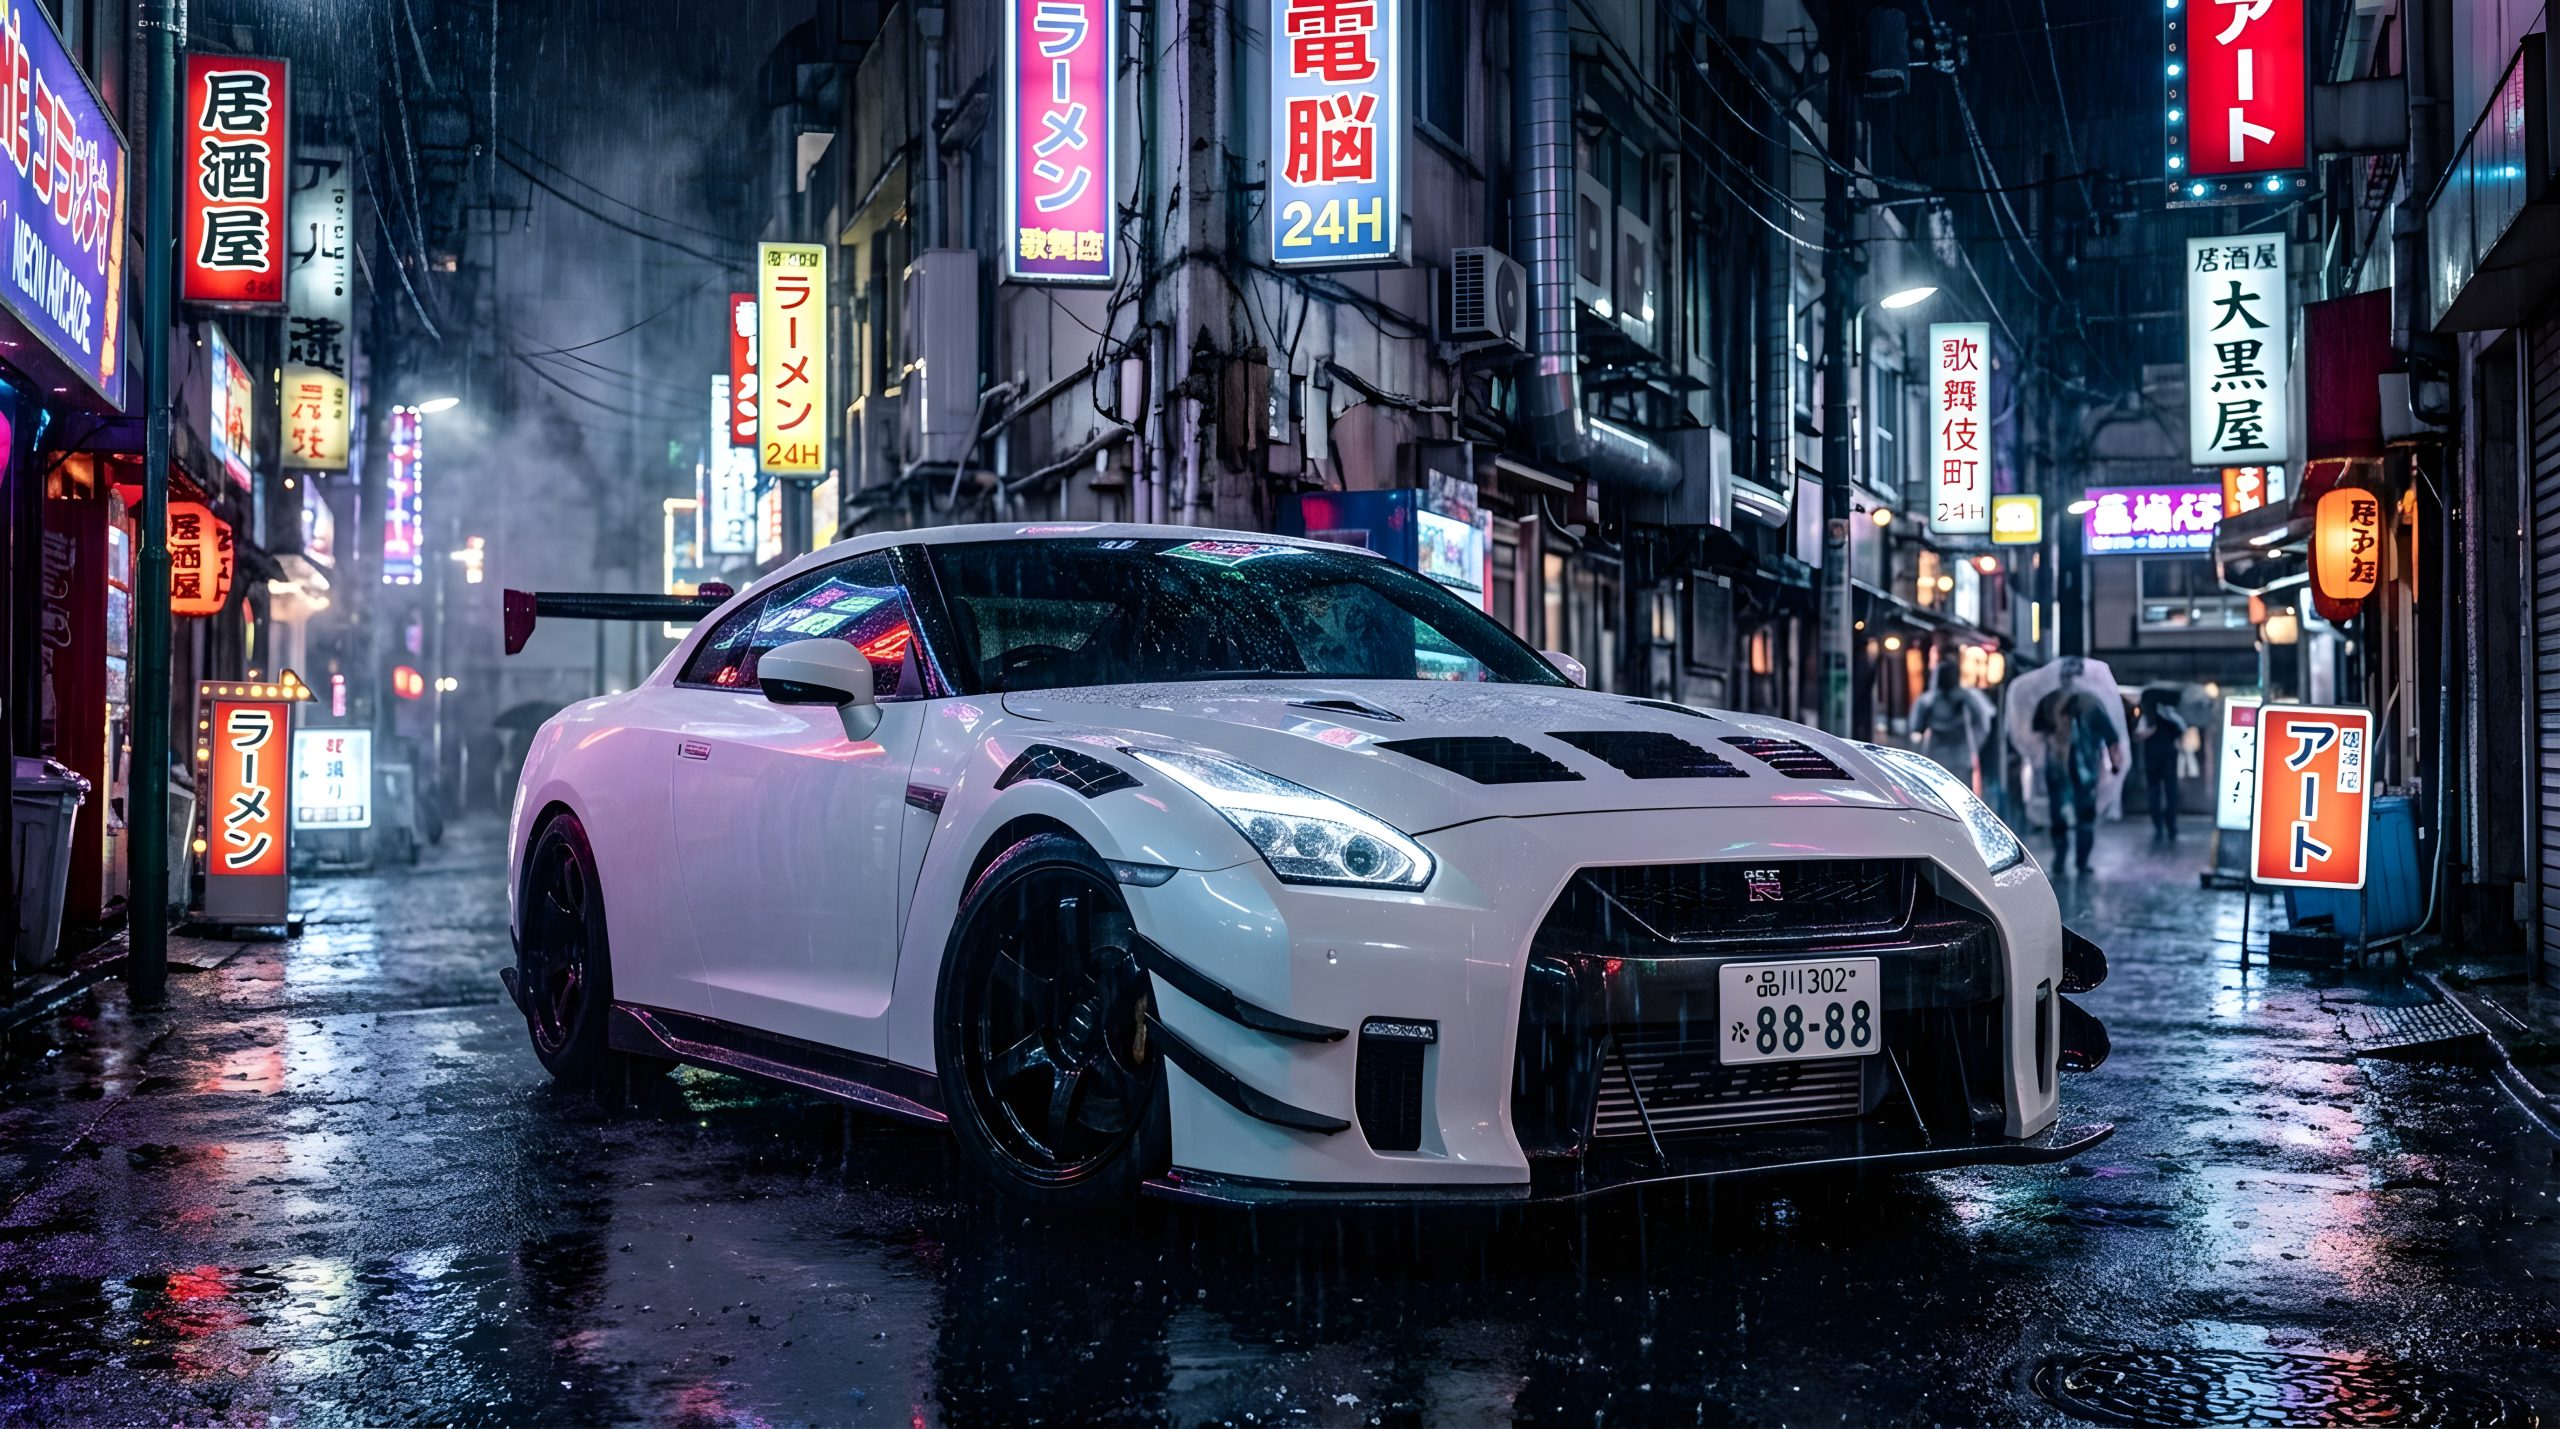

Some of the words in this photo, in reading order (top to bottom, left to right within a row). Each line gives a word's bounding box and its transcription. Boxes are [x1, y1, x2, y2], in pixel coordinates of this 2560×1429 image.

[1033, 3, 1092, 213] ラーメン
[1284, 0, 1378, 186] 電脳
[2215, 0, 2276, 163] アート
[198, 70, 271, 273] 居酒屋
[1282, 197, 1383, 247] 24H
[775, 276, 812, 431] ラーメン
[1942, 338, 1978, 491] 歌舞伎町
[2208, 280, 2270, 452] 大黒屋
[766, 443, 819, 466] 24H
[224, 709, 273, 868] ラーメン
[2285, 721, 2338, 872] アート
[1756, 999, 1872, 1055] 88-88
